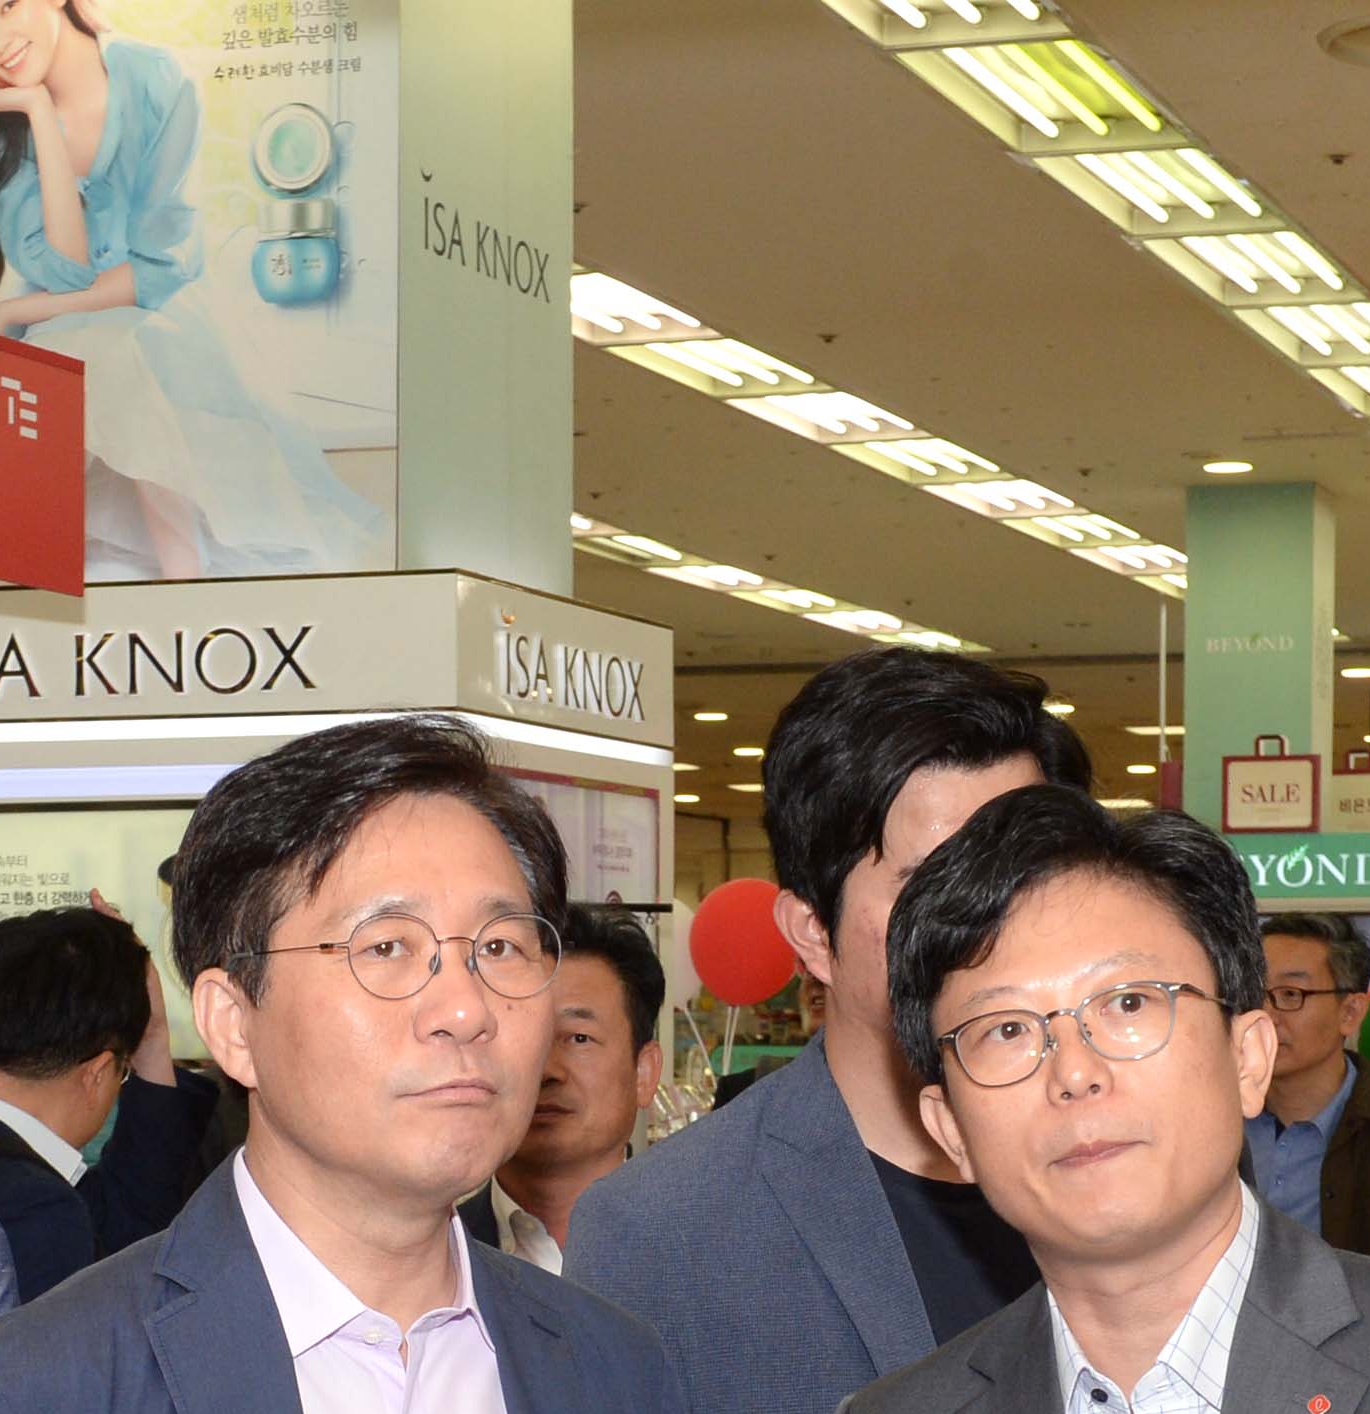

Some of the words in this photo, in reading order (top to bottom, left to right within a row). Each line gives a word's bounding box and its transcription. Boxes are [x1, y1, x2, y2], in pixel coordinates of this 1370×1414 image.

[222, 28, 254, 50] 깊은
[258, 22, 337, 48] 발효수분의
[343, 21, 358, 42] 힘
[476, 219, 551, 303] KNOX
[74, 624, 317, 698] KNOX
[1206, 634, 1294, 653] BEYOND
[555, 643, 646, 722] KNOX
[1240, 783, 1301, 804] SALE
